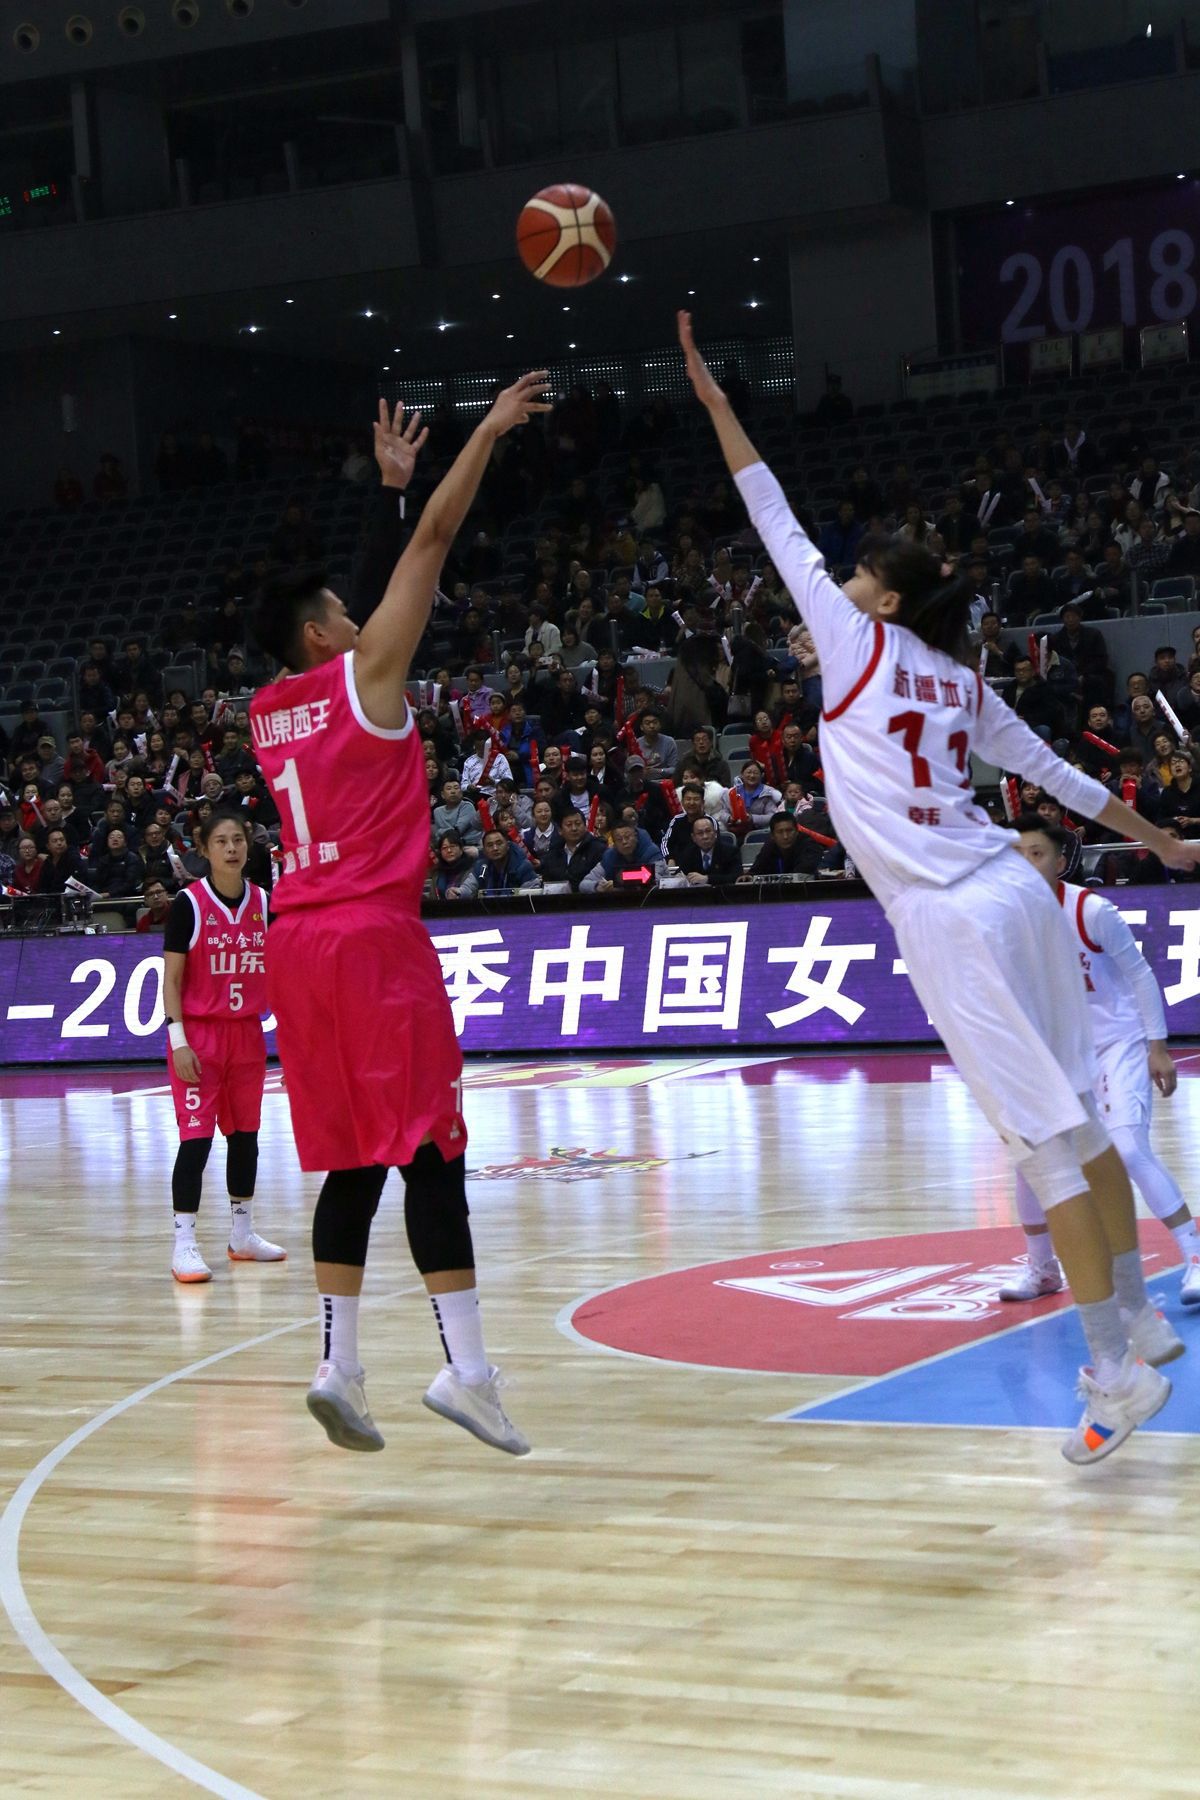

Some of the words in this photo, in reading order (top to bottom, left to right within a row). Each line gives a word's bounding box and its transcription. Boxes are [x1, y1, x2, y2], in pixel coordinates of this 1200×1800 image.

[999, 229, 1197, 344] 2018
[250, 699, 331, 748] 山東西王
[272, 758, 312, 845] 1
[210, 951, 265, 975] 山东
[431, 915, 905, 1037] 季中国女
[229, 983, 243, 1011] 5
[185, 1087, 201, 1110] 5
